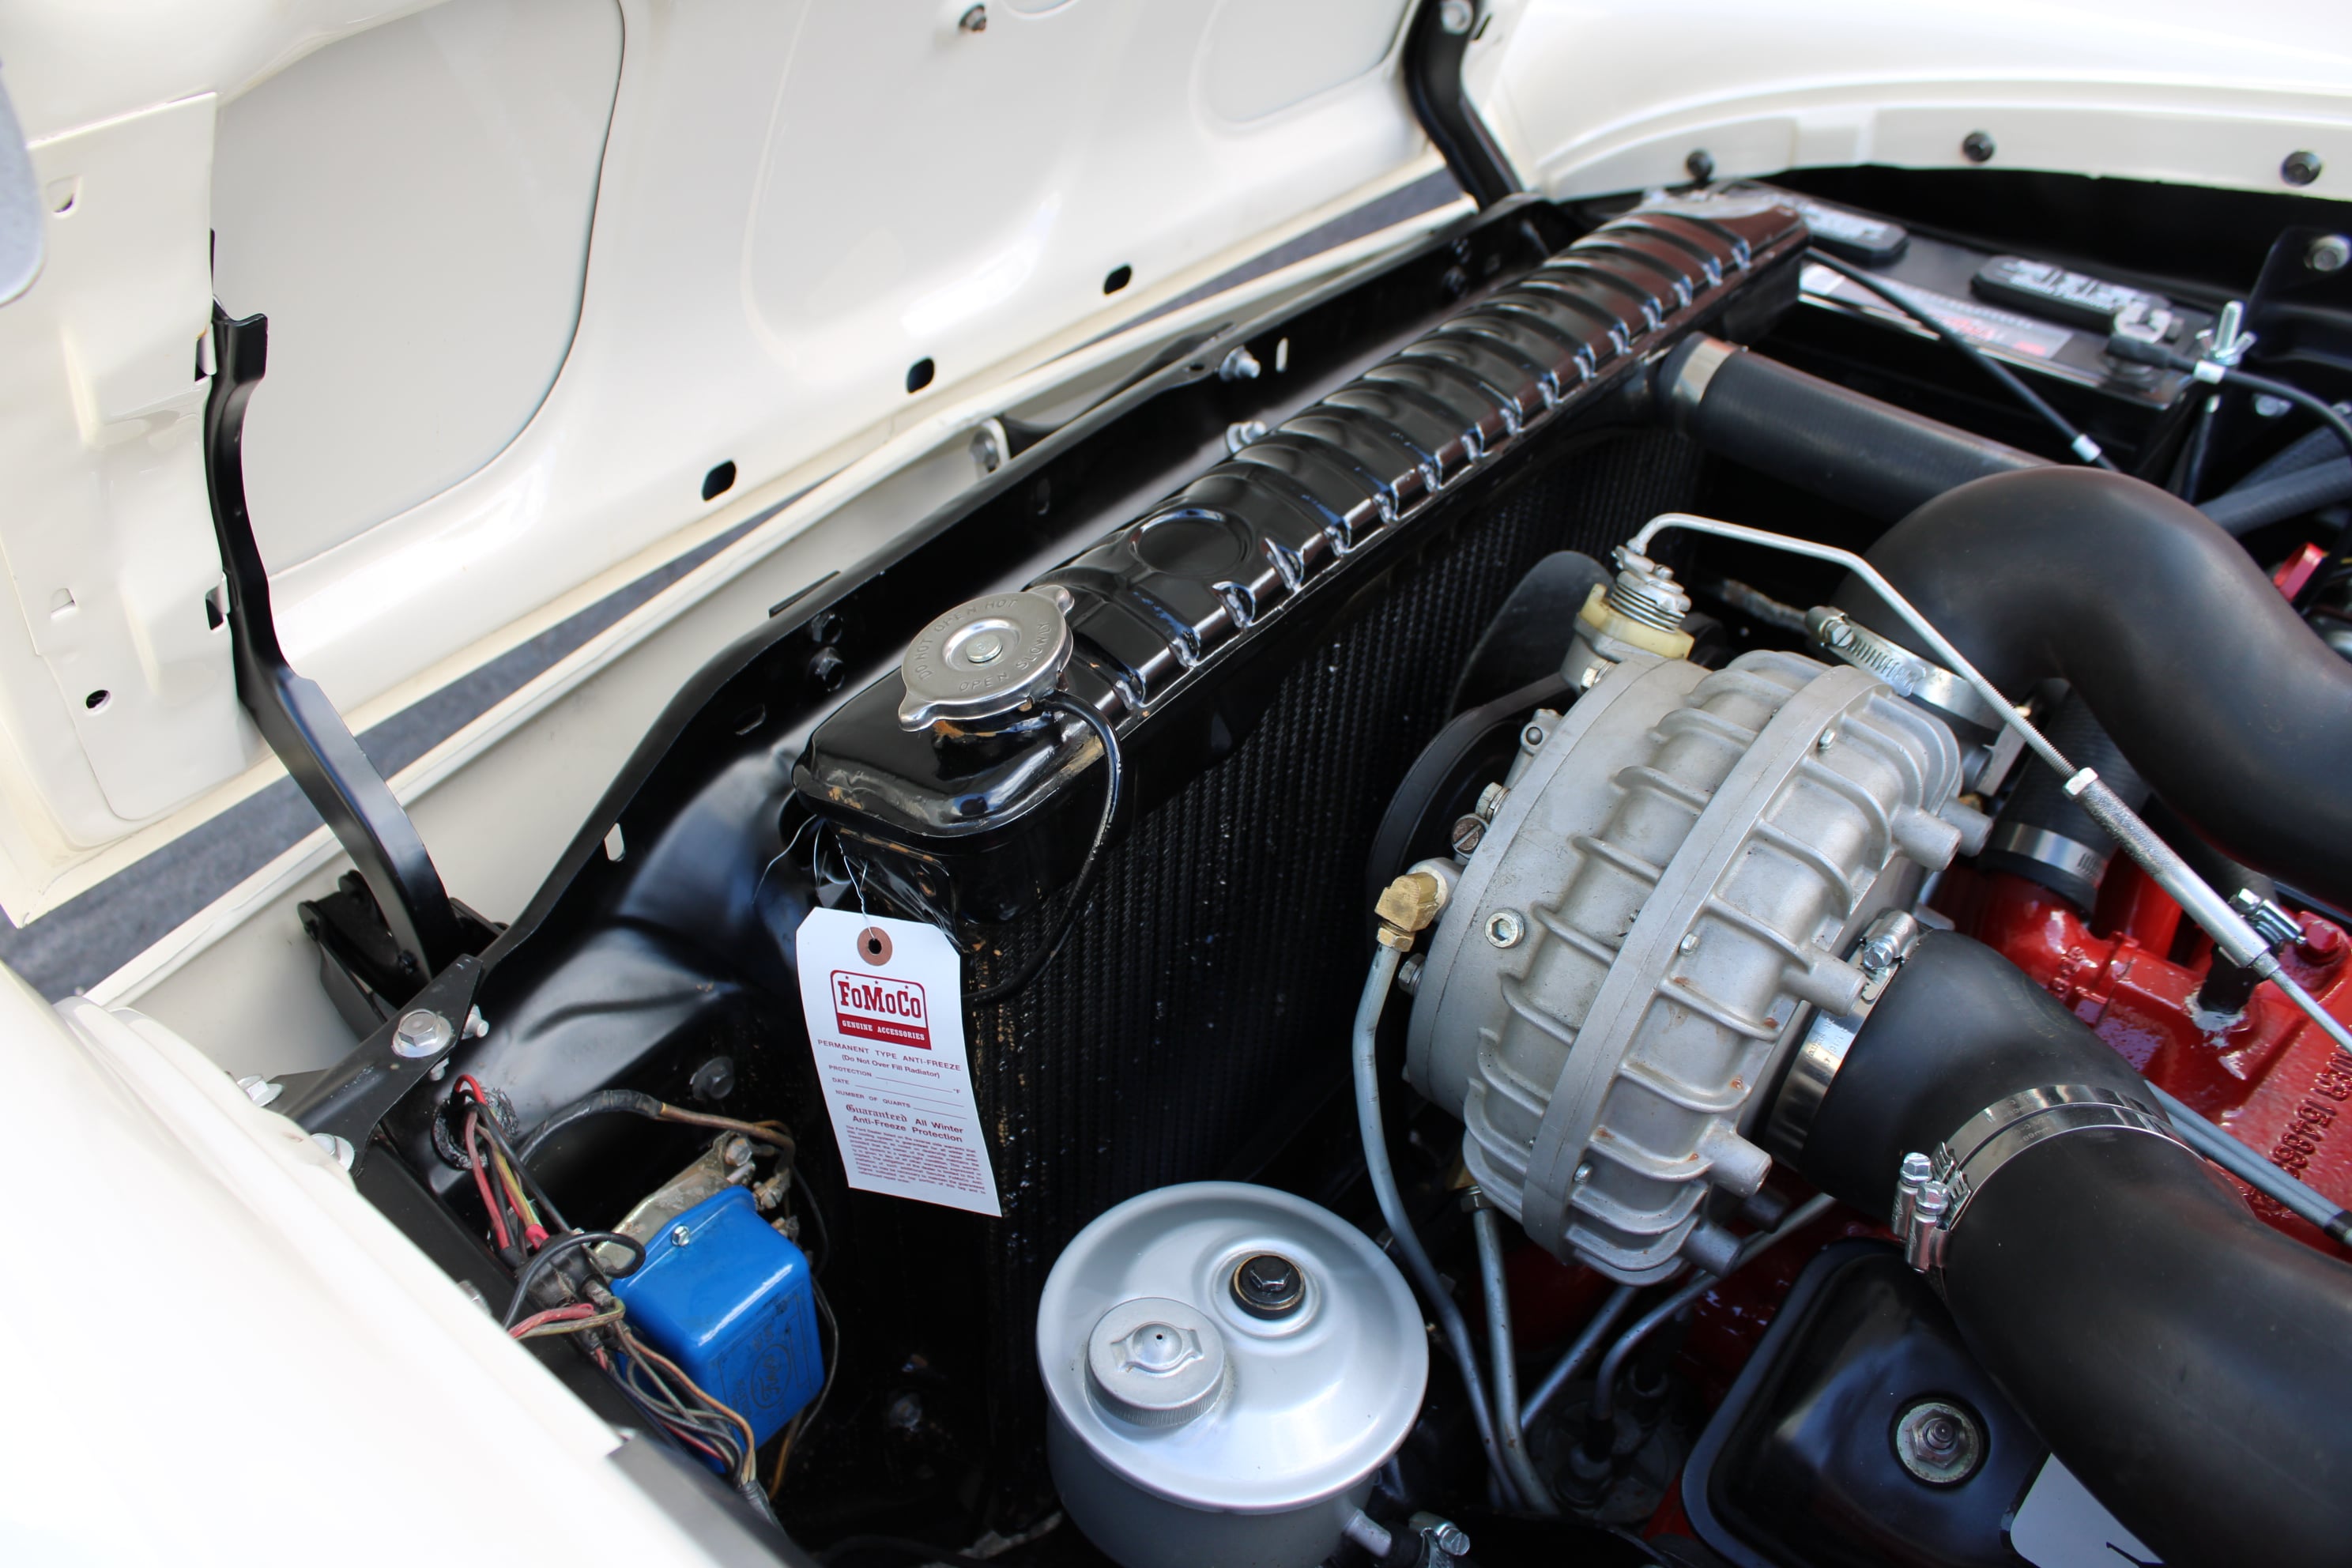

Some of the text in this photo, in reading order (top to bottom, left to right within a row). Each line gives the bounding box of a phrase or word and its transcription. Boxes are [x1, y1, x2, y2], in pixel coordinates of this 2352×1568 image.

[914, 597, 1019, 680] DO NOT OPEN HOT
[959, 620, 1051, 692] OPEN SLOWLY
[838, 981, 922, 1019] FoMoCo
[842, 1020, 925, 1041] GENUINE ACCESSORIES
[818, 1039, 961, 1071] PERMANENT TYPE ANTI-FREEZE
[829, 1065, 872, 1077] PROTECTION
[873, 1060, 890, 1069] Over
[905, 1065, 940, 1079] Radiator)
[835, 1090, 865, 1099] NUMBER
[882, 1099, 910, 1108] QUARTS
[846, 1104, 907, 1122] Guaranteed
[931, 1121, 963, 1134] Winter
[853, 1115, 963, 1142] Anti-Freeze Protection
